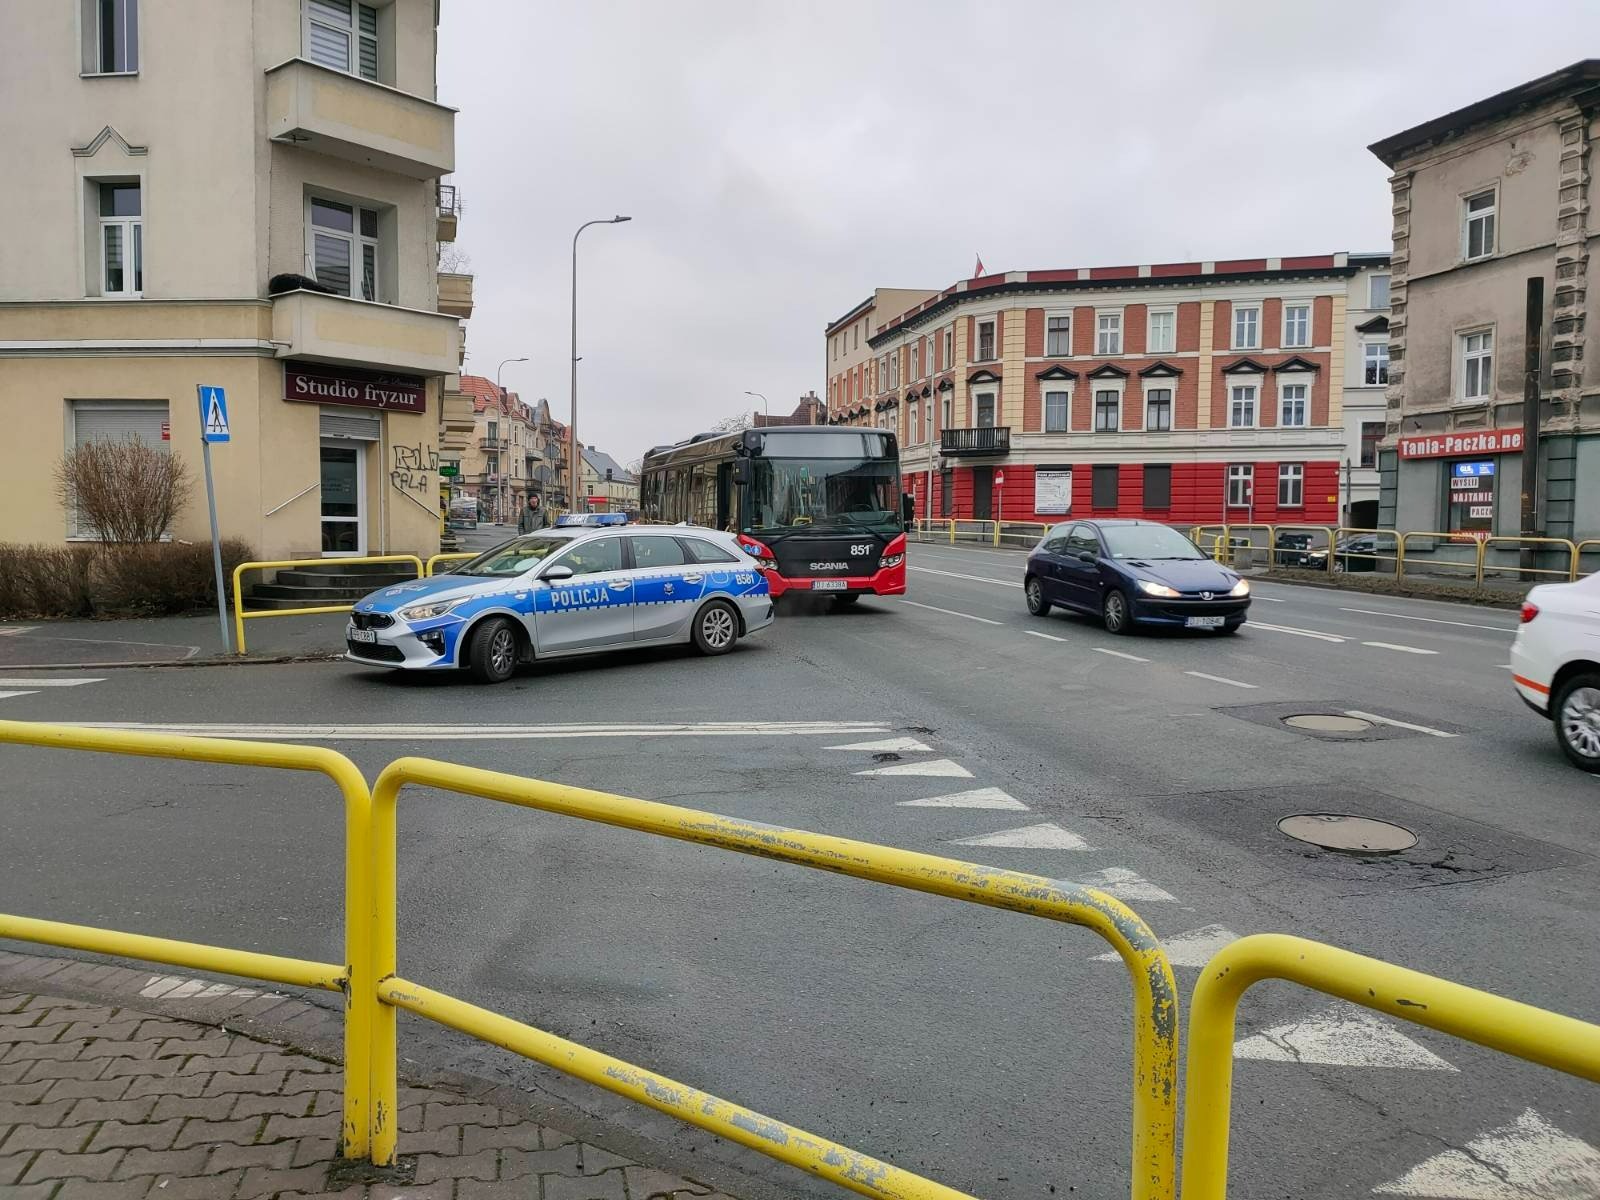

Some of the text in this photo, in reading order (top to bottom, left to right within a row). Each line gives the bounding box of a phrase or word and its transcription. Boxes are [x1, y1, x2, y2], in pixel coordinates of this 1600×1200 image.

[295, 376, 359, 399] Studio
[365, 384, 417, 407] fryzur
[850, 544, 870, 555] 851
[809, 562, 849, 570] SCANIA
[735, 574, 755, 585] B581
[550, 587, 610, 607] POLICJA
